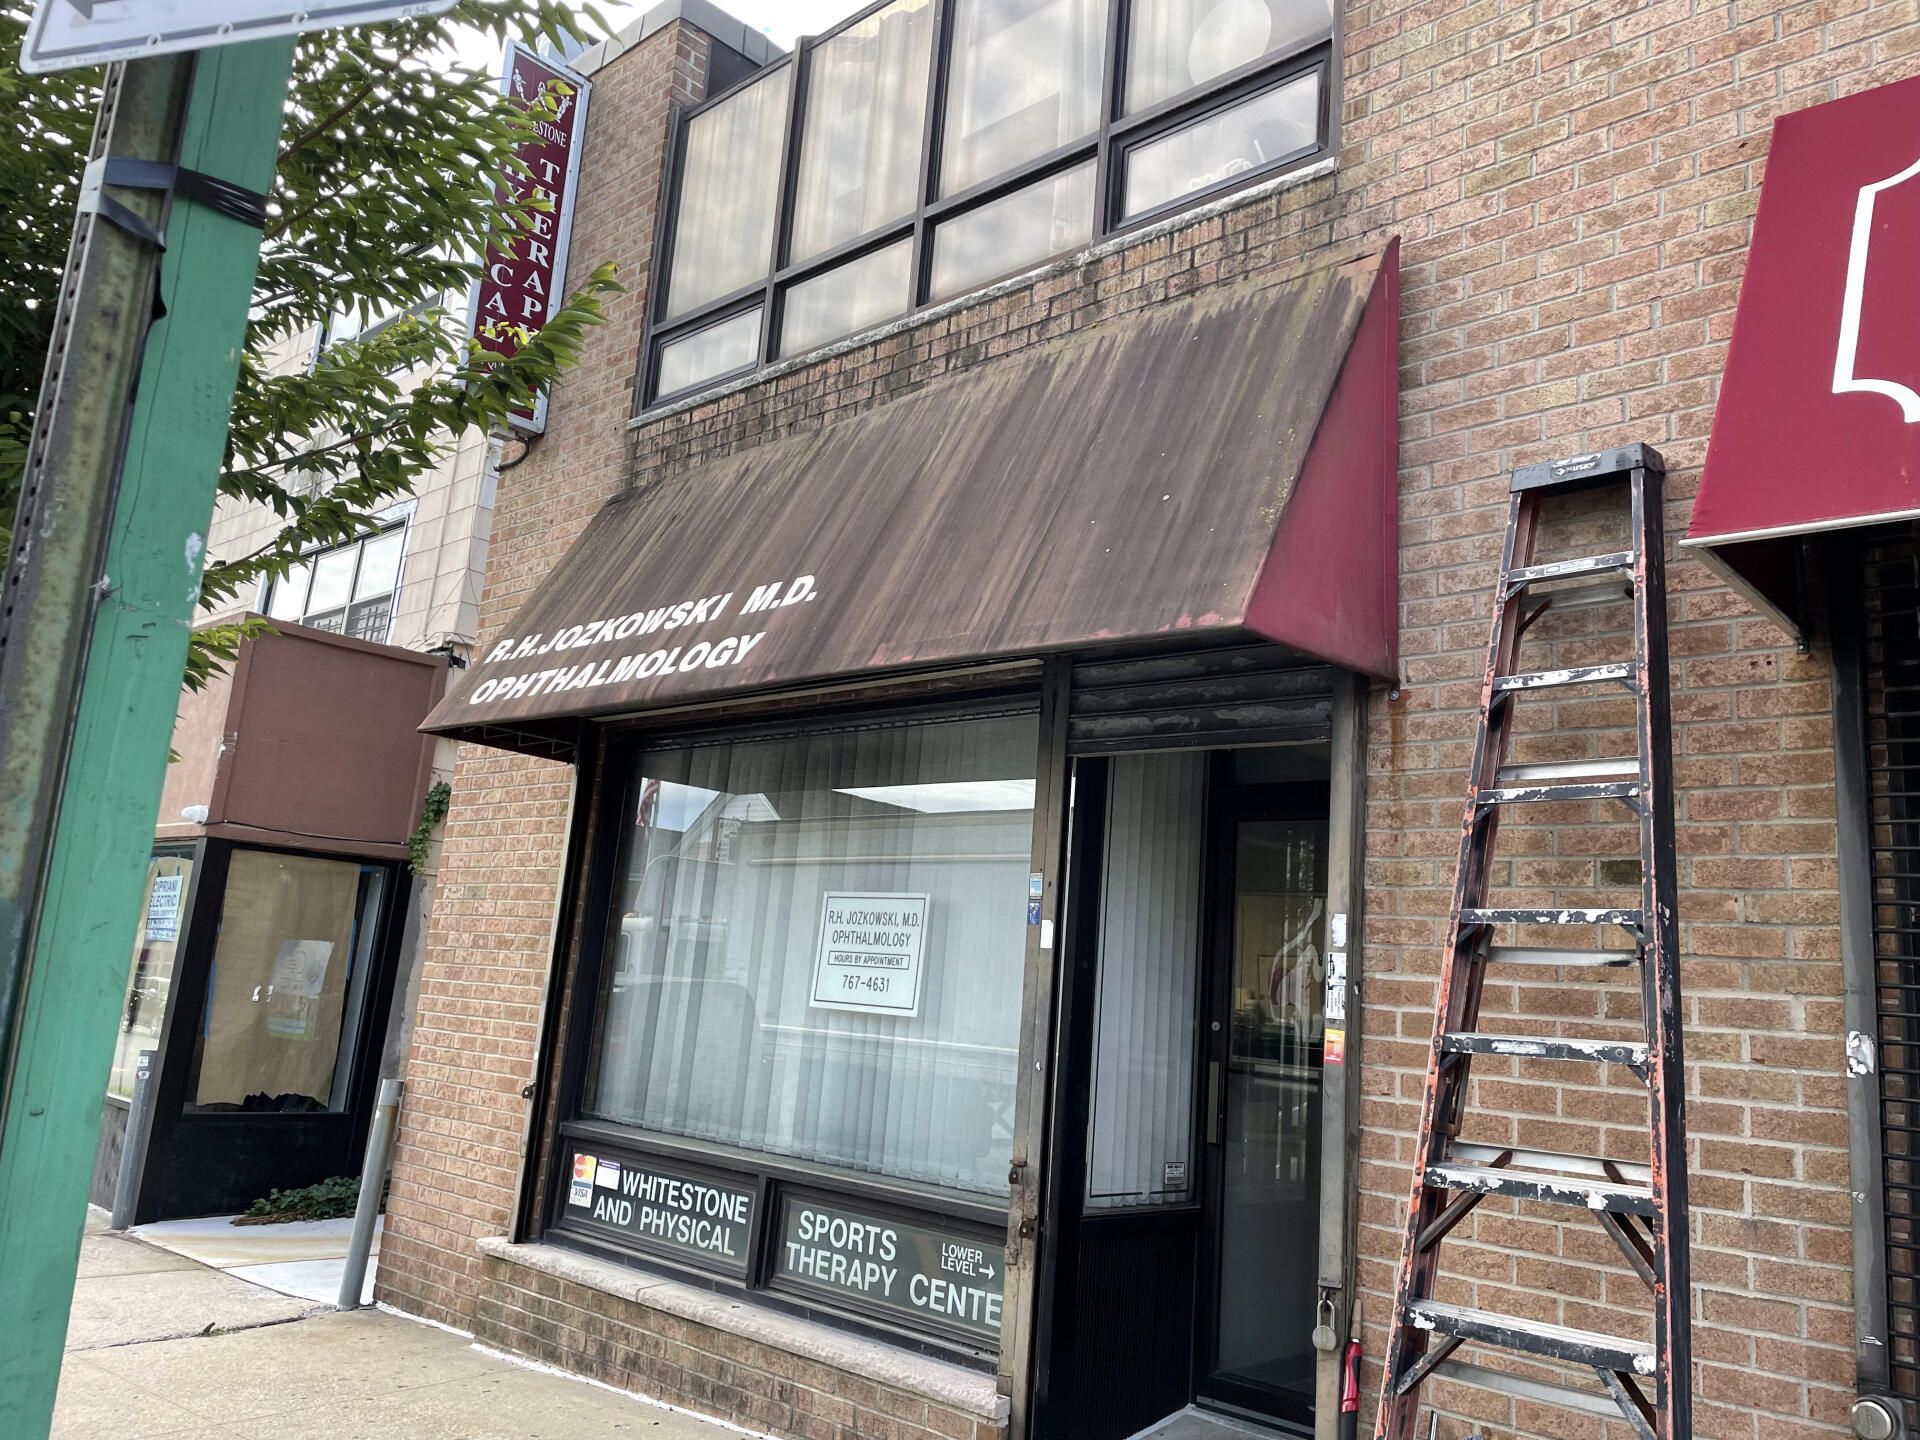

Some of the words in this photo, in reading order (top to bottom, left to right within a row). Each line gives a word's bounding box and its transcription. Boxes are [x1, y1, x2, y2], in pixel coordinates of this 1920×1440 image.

[739, 574, 818, 615] M.D.
[469, 632, 767, 705] OPHTHALMOLOGY
[828, 910, 843, 925] R.H.
[846, 911, 899, 927] JOZKOWSKI,
[902, 912, 920, 927] M.D.
[832, 930, 911, 947] OPHTHALMOLOGY
[834, 954, 853, 964] HOURS
[854, 955, 862, 964] BY
[863, 956, 904, 967] APPOINTMENT
[842, 975, 890, 992] 767-4631
[575, 1187, 588, 1198] VISA
[622, 1169, 749, 1224] WHITESTONE
[593, 1195, 632, 1226] AND
[639, 1206, 735, 1256] PHYSICAL
[798, 1210, 898, 1261] SPORTS
[942, 1242, 983, 1264] LOWER
[941, 1255, 976, 1277] LEVEL
[786, 1241, 898, 1297] THERAPY
[909, 1273, 1003, 1328] CENTE
